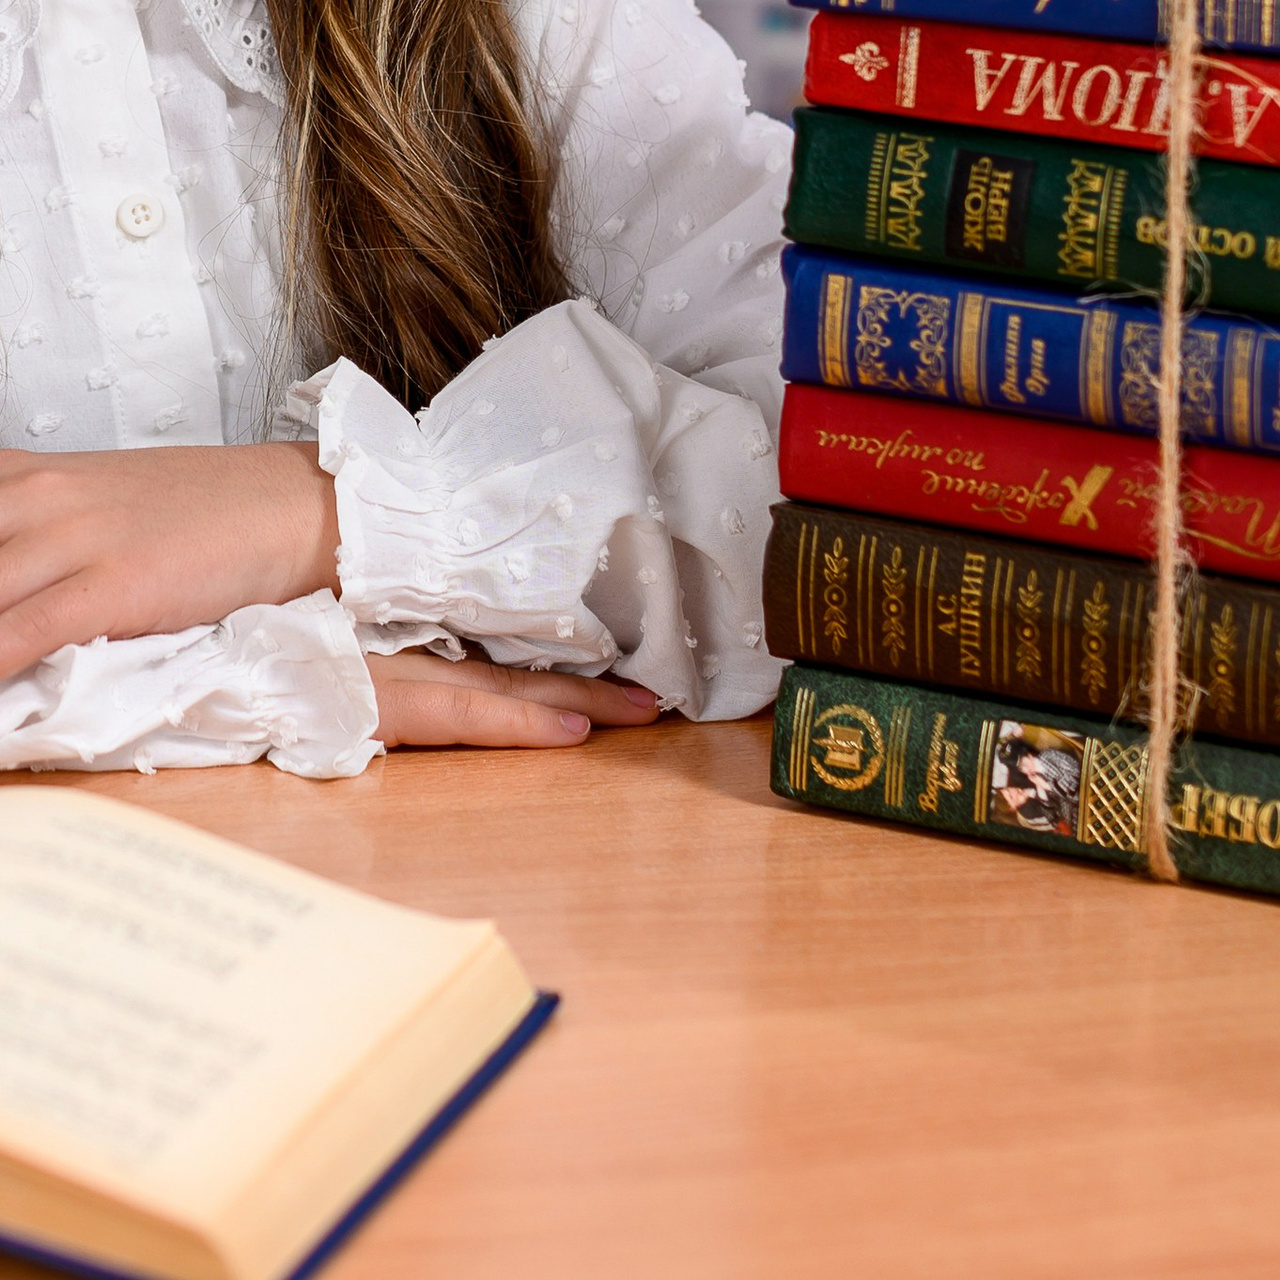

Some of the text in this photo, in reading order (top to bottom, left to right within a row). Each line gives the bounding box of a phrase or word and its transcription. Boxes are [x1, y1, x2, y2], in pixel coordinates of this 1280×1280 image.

[963, 157, 993, 252] ЖЮЛЬ
[986, 167, 1014, 243] ВЕРН
[815, 429, 986, 471] по мукам
[921, 464, 1113, 531] Хождение
